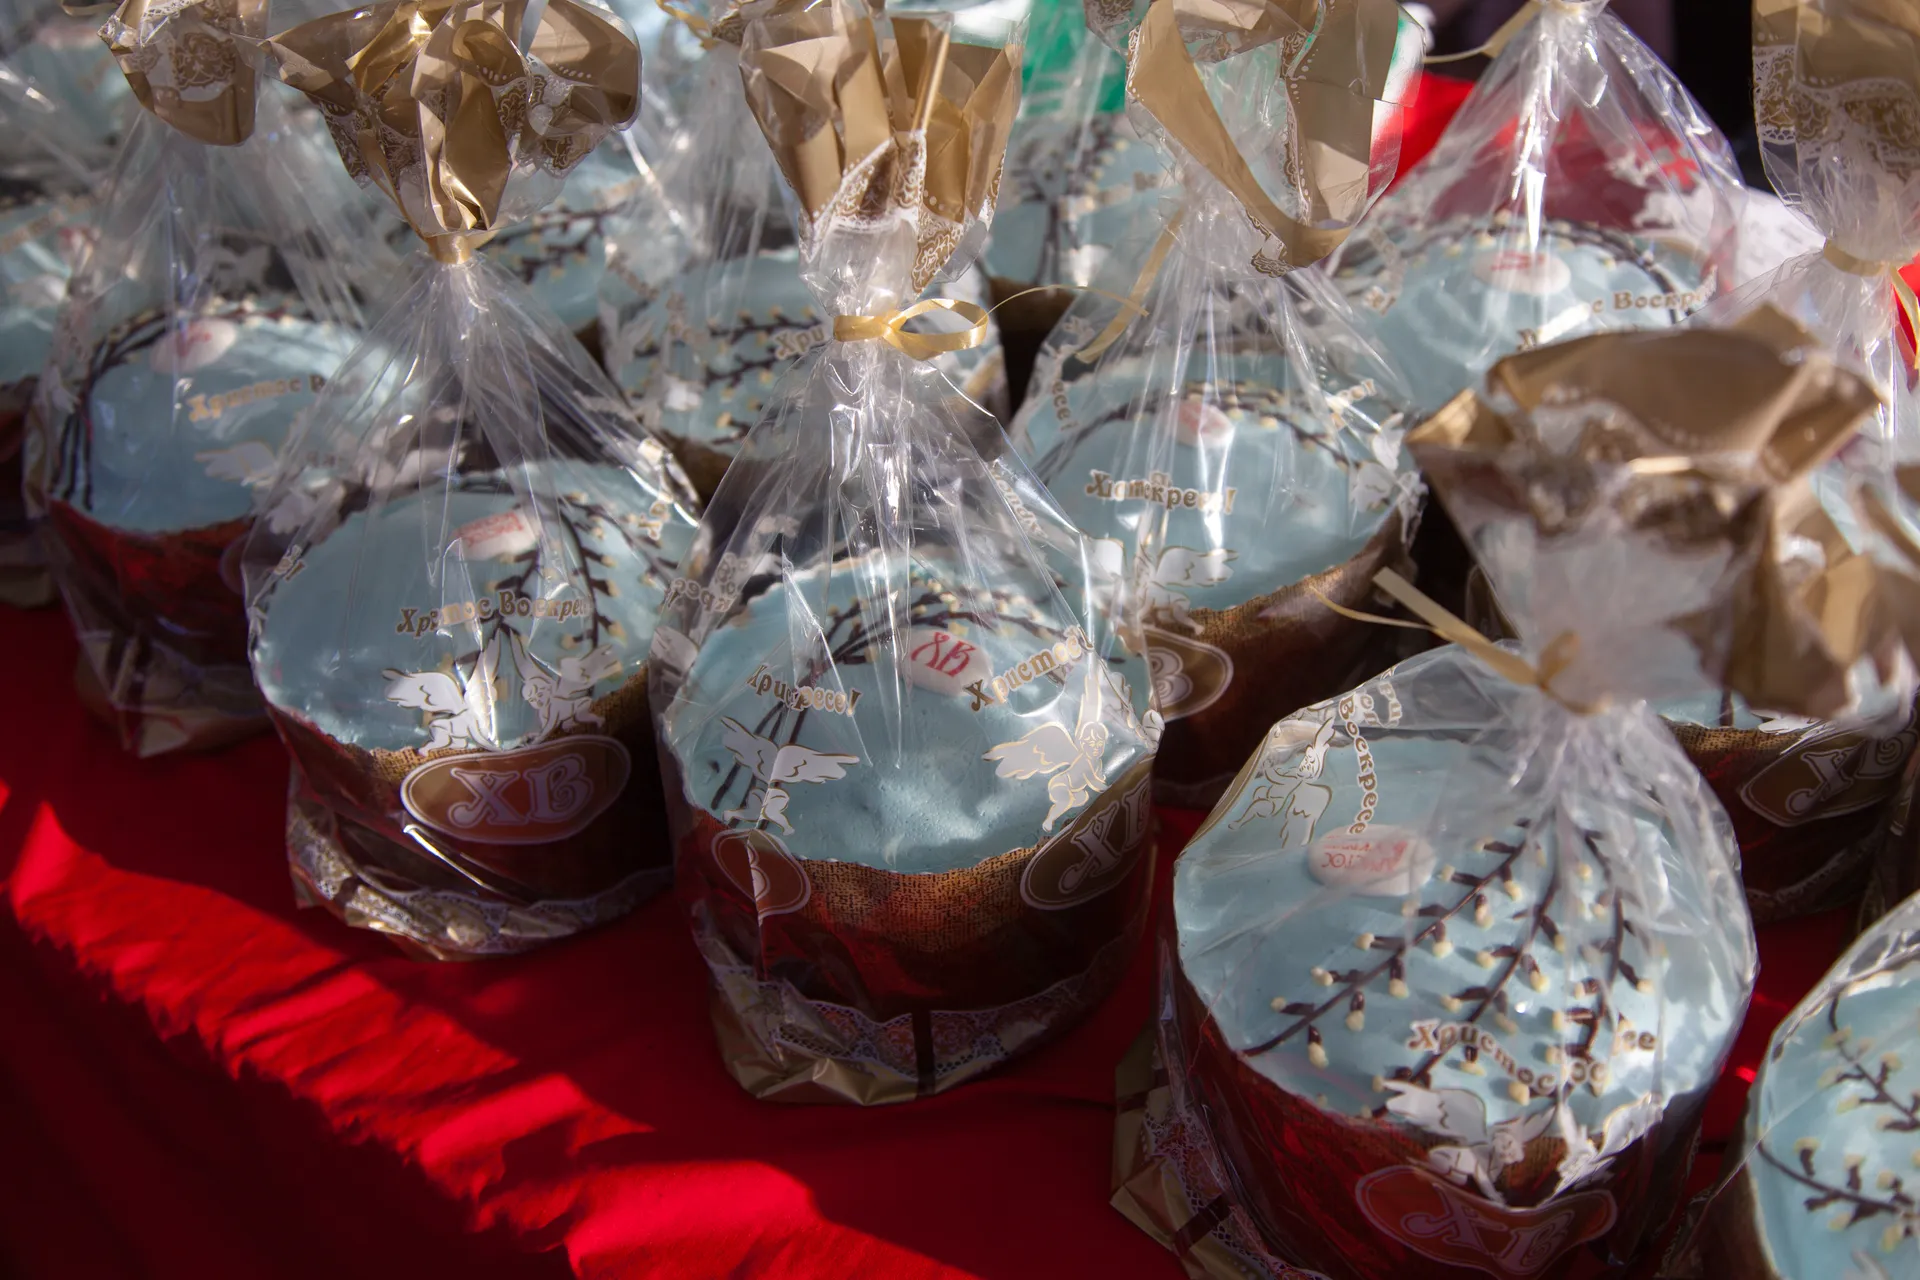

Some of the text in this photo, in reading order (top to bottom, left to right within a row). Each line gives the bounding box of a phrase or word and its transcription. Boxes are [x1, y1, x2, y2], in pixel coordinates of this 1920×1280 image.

[397, 599, 492, 636] Хртос
[911, 632, 975, 677] ХВ
[448, 753, 594, 828] ХВ
[1401, 1183, 1575, 1276] ХВ
